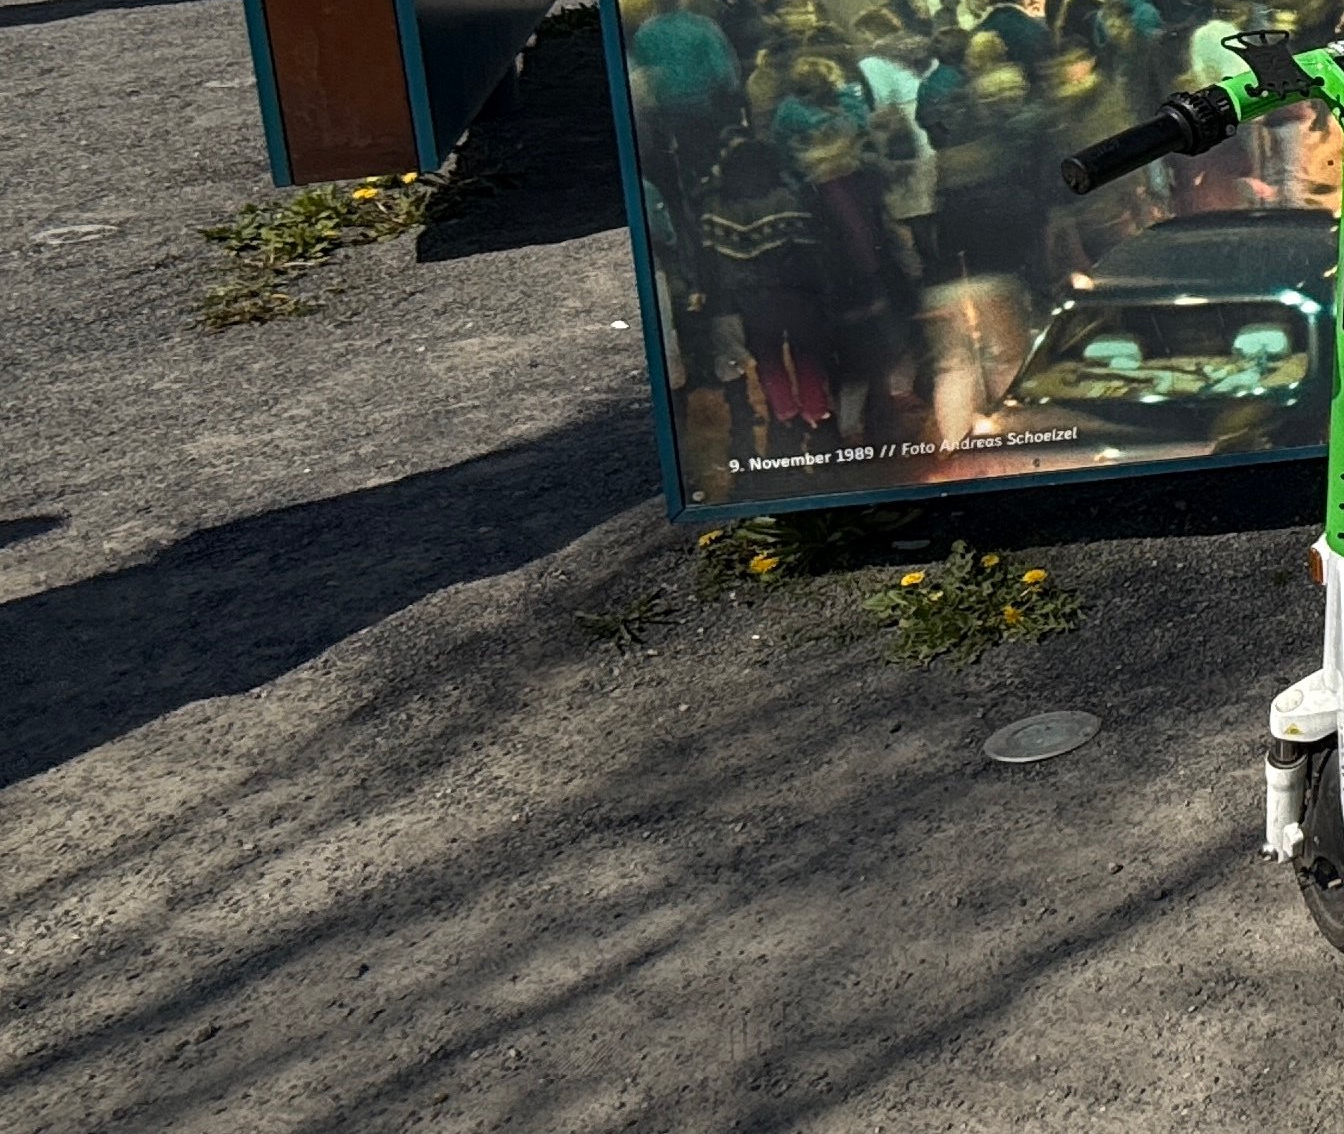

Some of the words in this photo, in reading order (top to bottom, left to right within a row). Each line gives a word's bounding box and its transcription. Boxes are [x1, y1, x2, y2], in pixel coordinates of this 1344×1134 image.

[728, 459, 746, 474] 9.
[748, 452, 832, 472] November
[836, 446, 874, 463] 1989
[901, 442, 936, 456] Foto
[939, 435, 1003, 453] Andreas
[1006, 426, 1078, 446] Schoelzel
